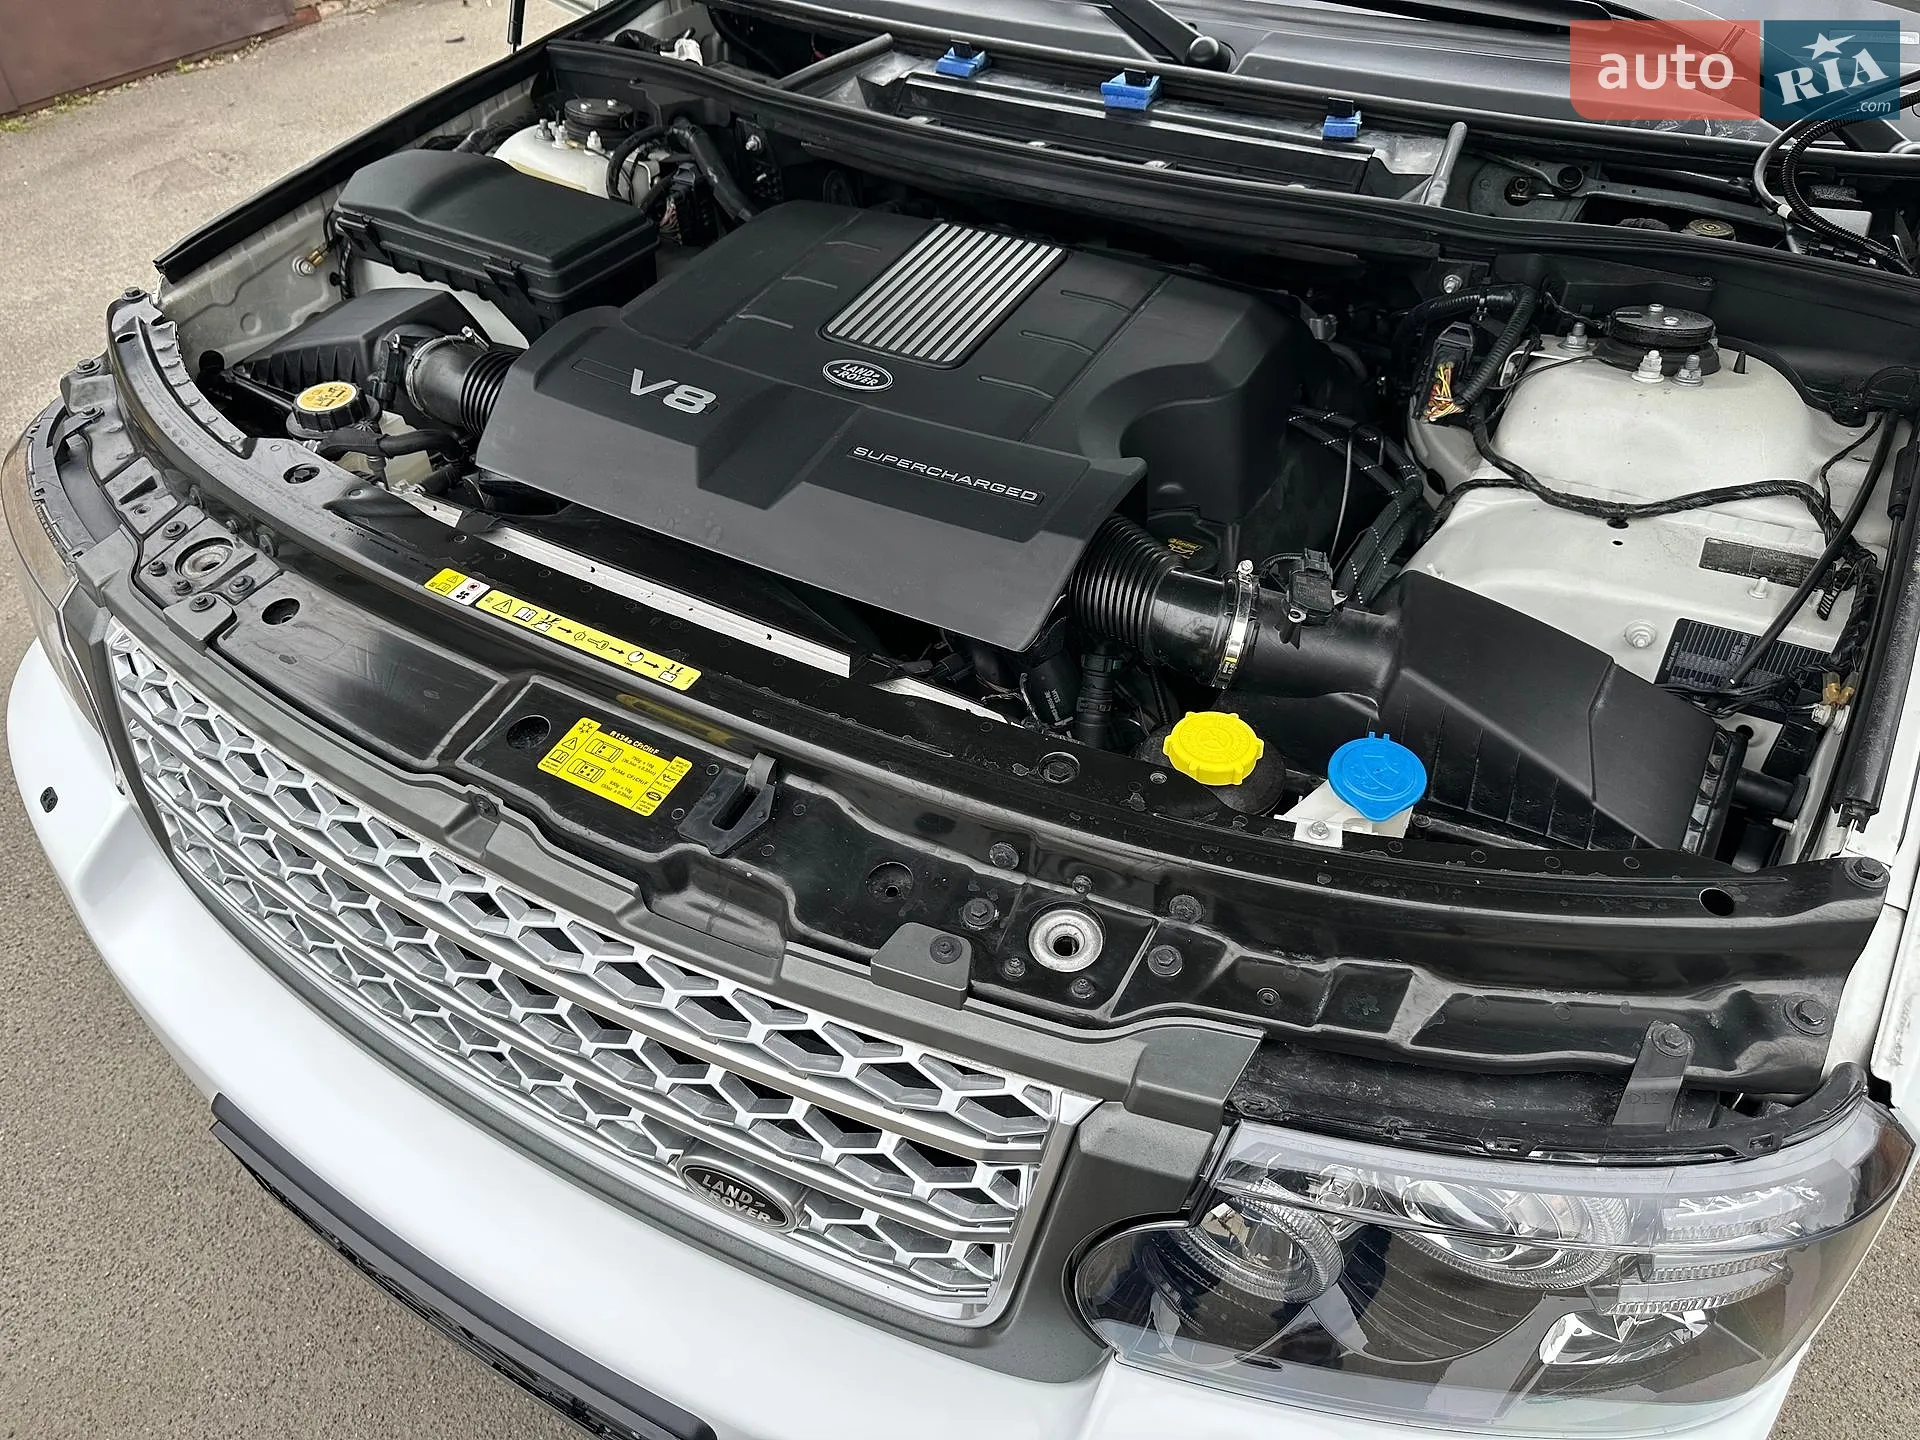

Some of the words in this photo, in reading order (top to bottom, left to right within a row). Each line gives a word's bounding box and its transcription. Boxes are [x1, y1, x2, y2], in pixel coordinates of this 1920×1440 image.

[837, 370, 879, 387] ROVER
[840, 363, 875, 377] LAND
[630, 368, 717, 414] V8
[853, 446, 1038, 501] SUPERCHARGED
[702, 1174, 753, 1204] LAND
[708, 1189, 771, 1223] ROVER
